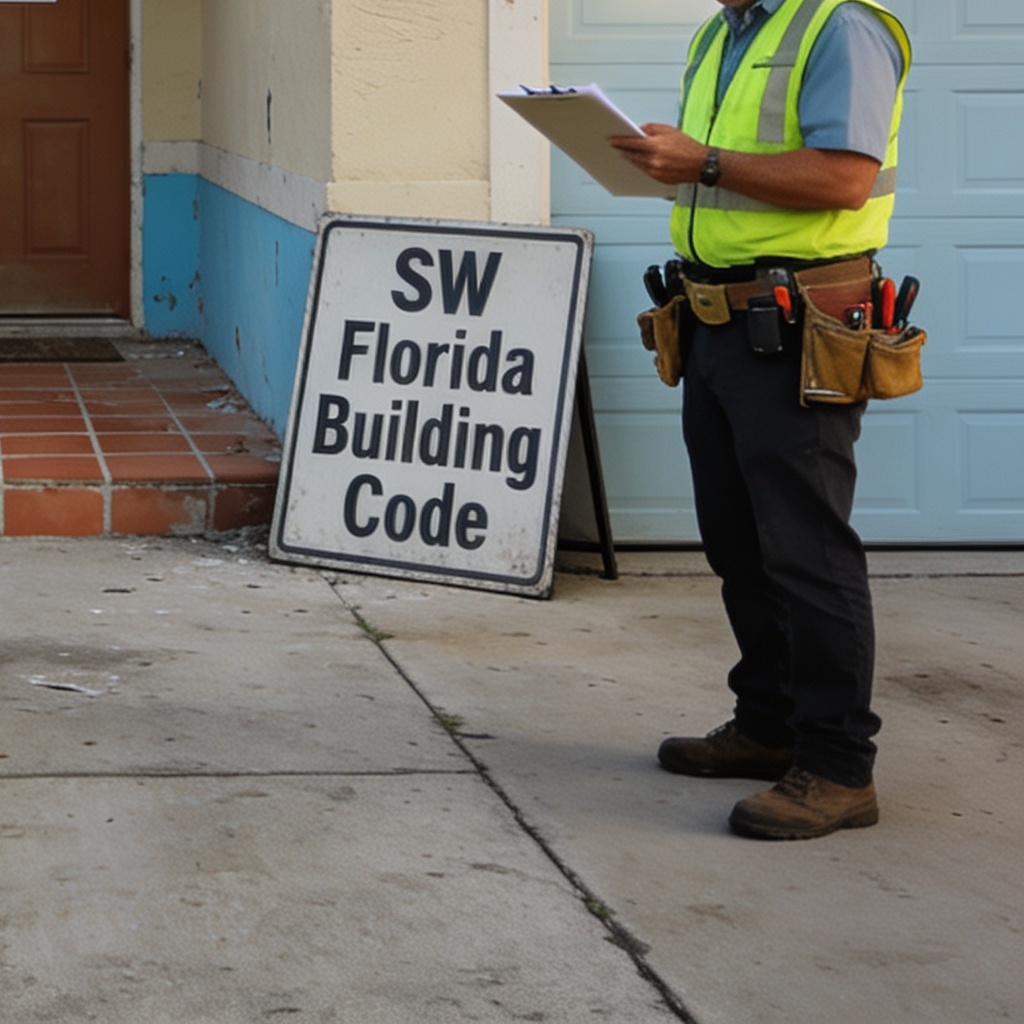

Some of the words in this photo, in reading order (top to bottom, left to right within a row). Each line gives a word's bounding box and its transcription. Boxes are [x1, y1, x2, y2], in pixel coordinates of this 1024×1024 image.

[391, 247, 503, 316] SW
[337, 319, 535, 396] Florida
[312, 393, 542, 491] Building
[343, 474, 489, 550] Code
